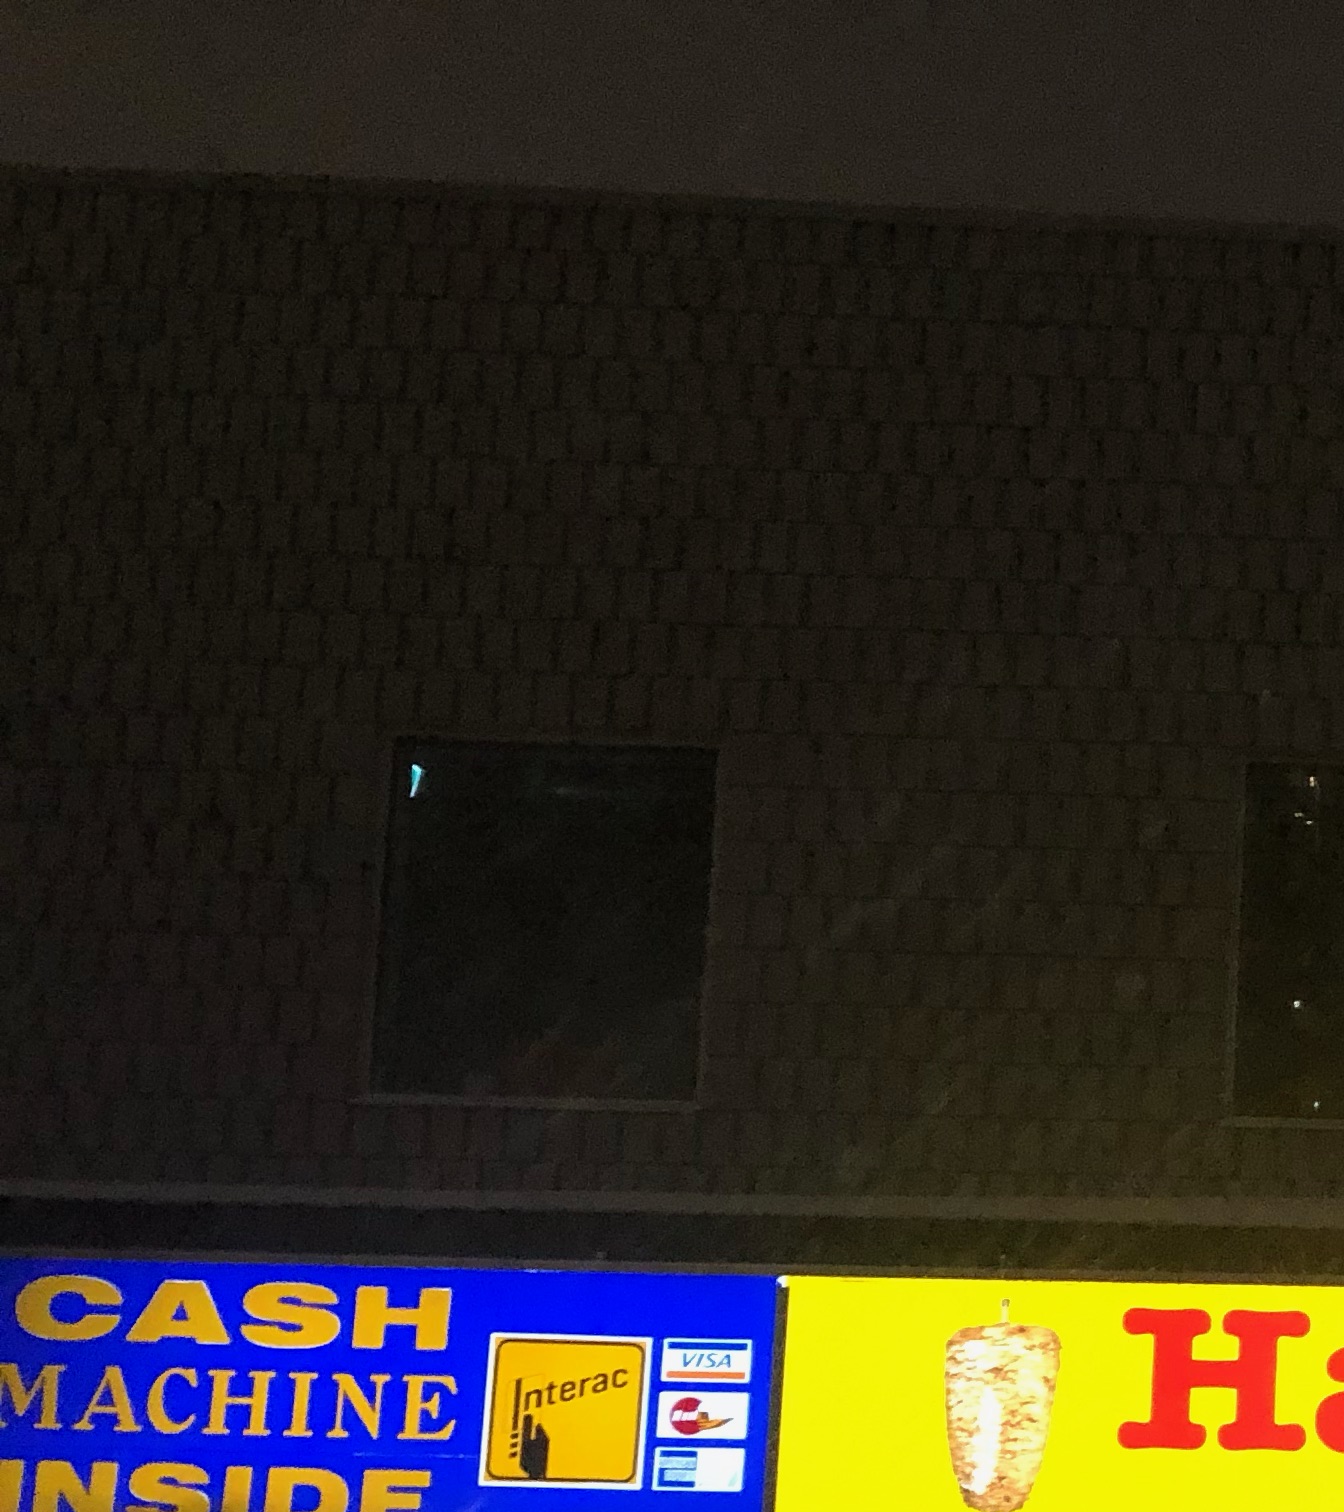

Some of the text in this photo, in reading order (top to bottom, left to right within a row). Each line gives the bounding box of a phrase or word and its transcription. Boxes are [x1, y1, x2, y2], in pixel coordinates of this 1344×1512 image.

[15, 1275, 452, 1350] CASH
[682, 1353, 731, 1368] VISA
[0, 1362, 458, 1440] MACHINE
[510, 1365, 629, 1432] Interac
